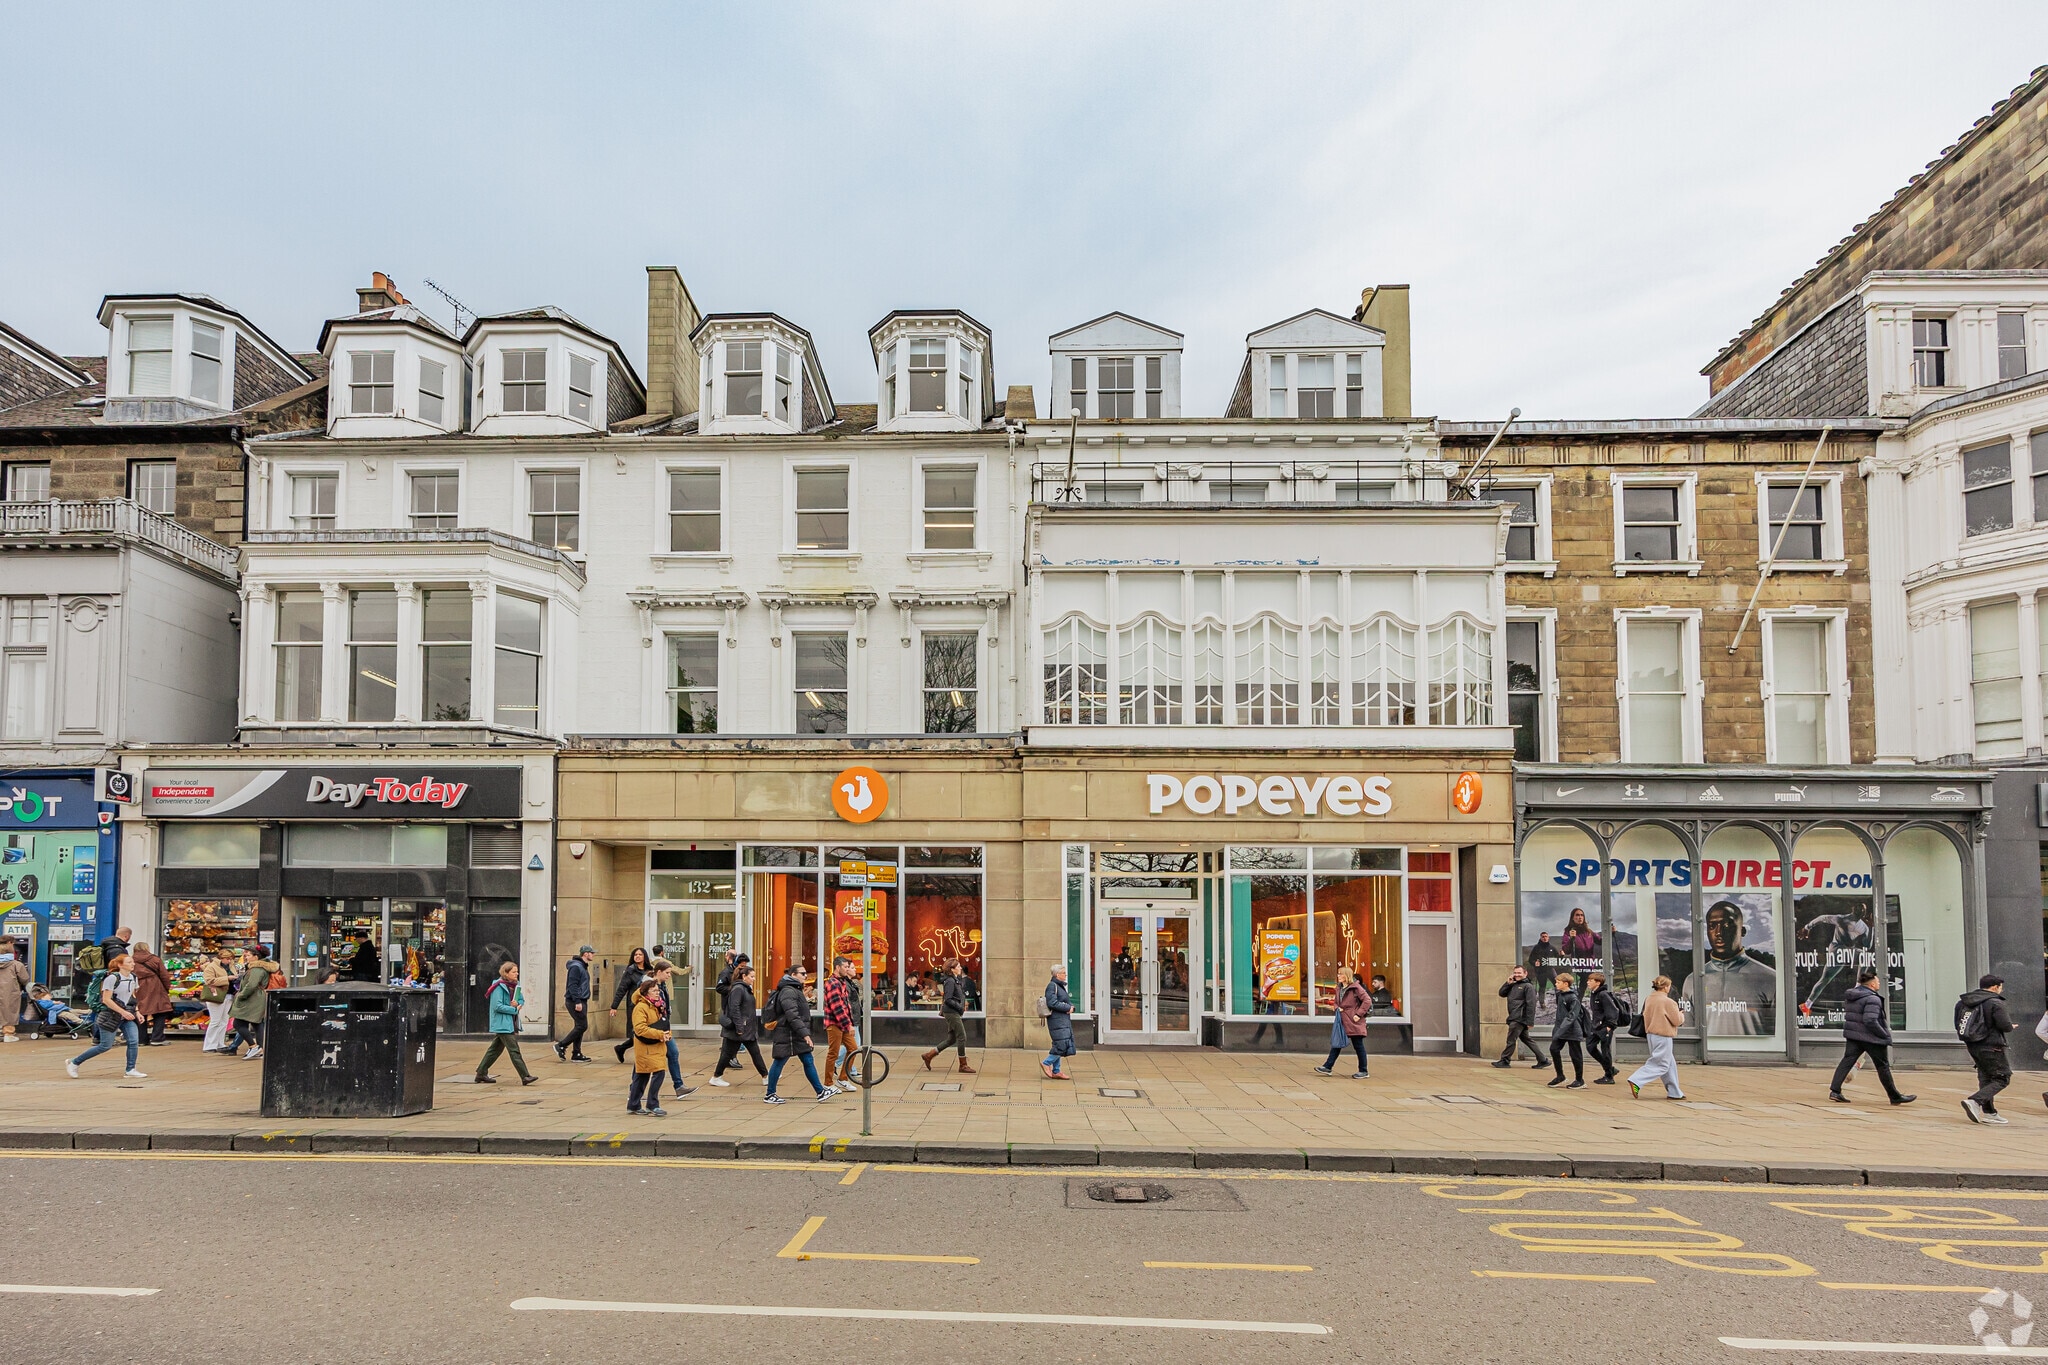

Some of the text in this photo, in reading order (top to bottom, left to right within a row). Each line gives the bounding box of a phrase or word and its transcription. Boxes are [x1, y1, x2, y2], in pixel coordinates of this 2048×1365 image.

[158, 787, 209, 797] Independent
[306, 776, 468, 809] Day-Today
[1775, 793, 1801, 802] PUMA
[688, 881, 711, 894] 132
[866, 901, 876, 918] H
[8, 926, 29, 934] ATM
[663, 931, 686, 945] 132
[710, 932, 733, 946] 132
[1558, 957, 1614, 967] KARRIM
[1826, 947, 1835, 967] in
[1836, 947, 1855, 969] any
[1859, 947, 1905, 967] direion
[1678, 997, 1747, 1016] the problem
[1959, 1011, 1972, 1036] adidas
